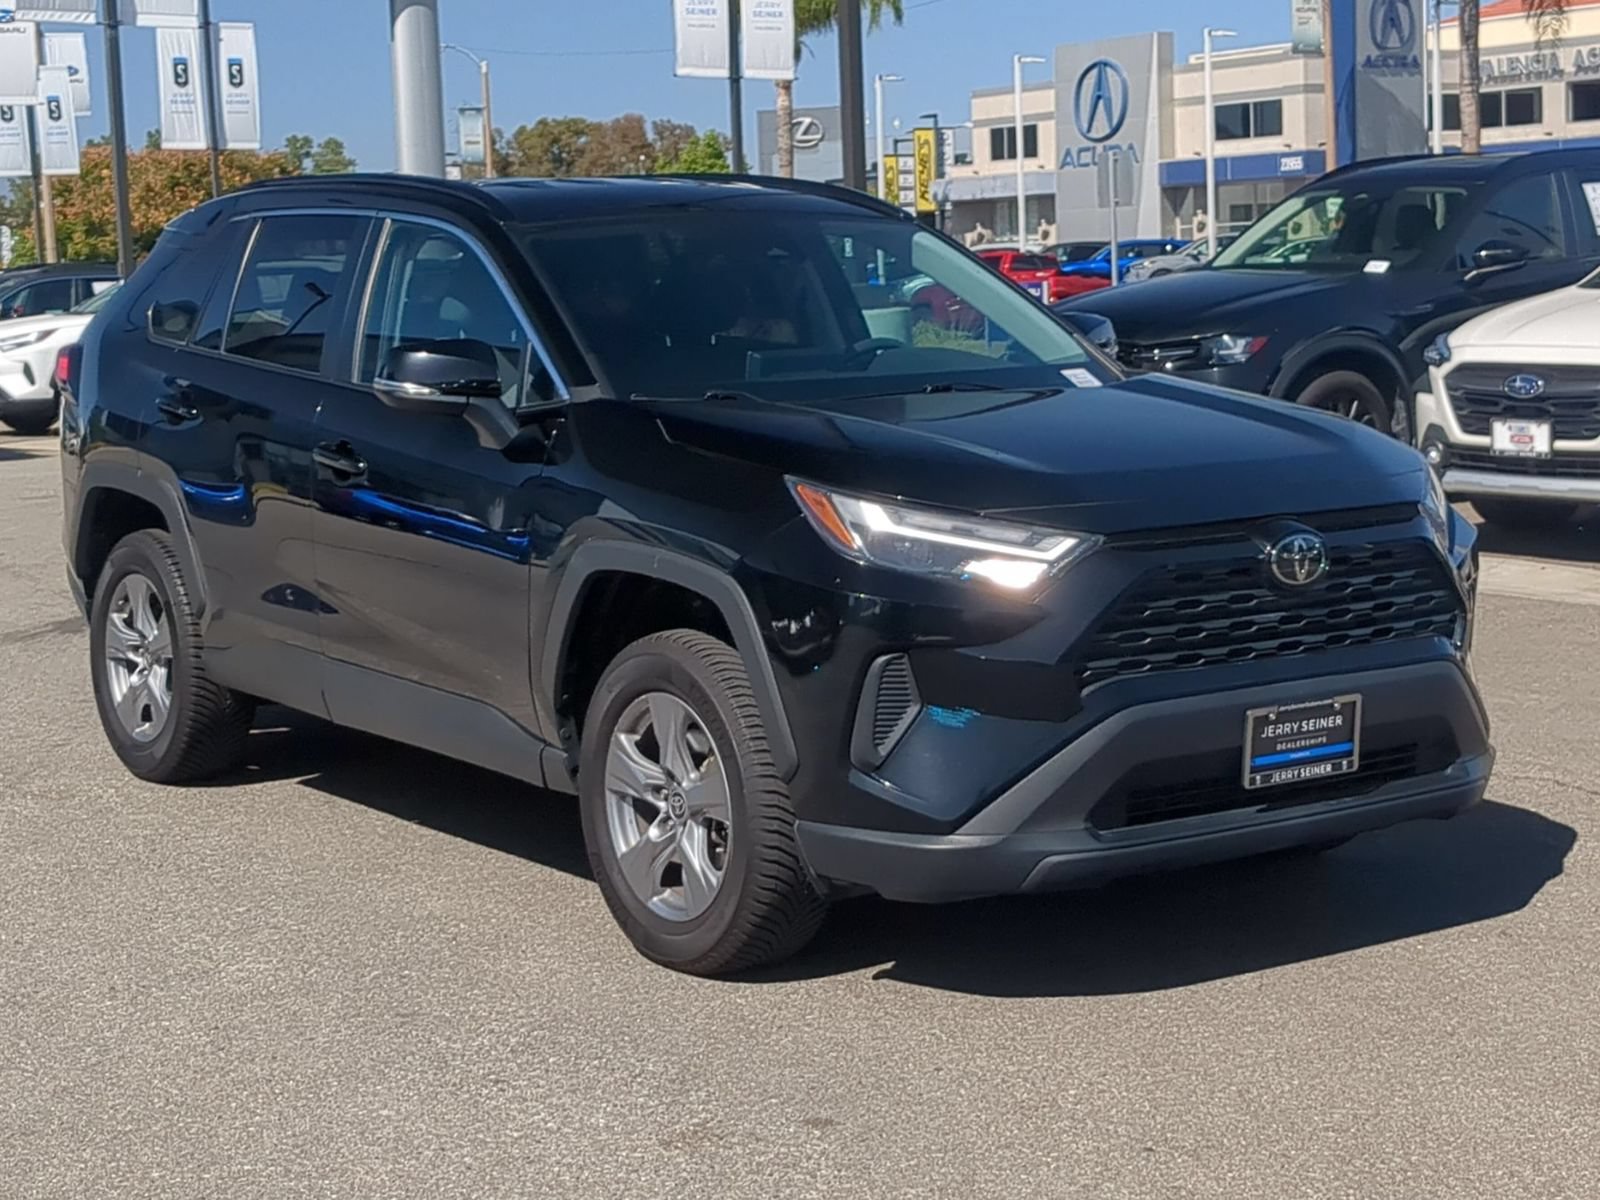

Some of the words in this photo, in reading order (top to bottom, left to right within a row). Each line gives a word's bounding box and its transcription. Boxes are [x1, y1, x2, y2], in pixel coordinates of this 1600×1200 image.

[1479, 51, 1561, 77] ALENCIA
[1261, 721, 1299, 738] JERRY
[1301, 715, 1343, 732] SEINER
[1276, 736, 1327, 751] DEALERSHIPS
[1271, 770, 1299, 783] JERRY
[1300, 763, 1333, 778] SEINER
